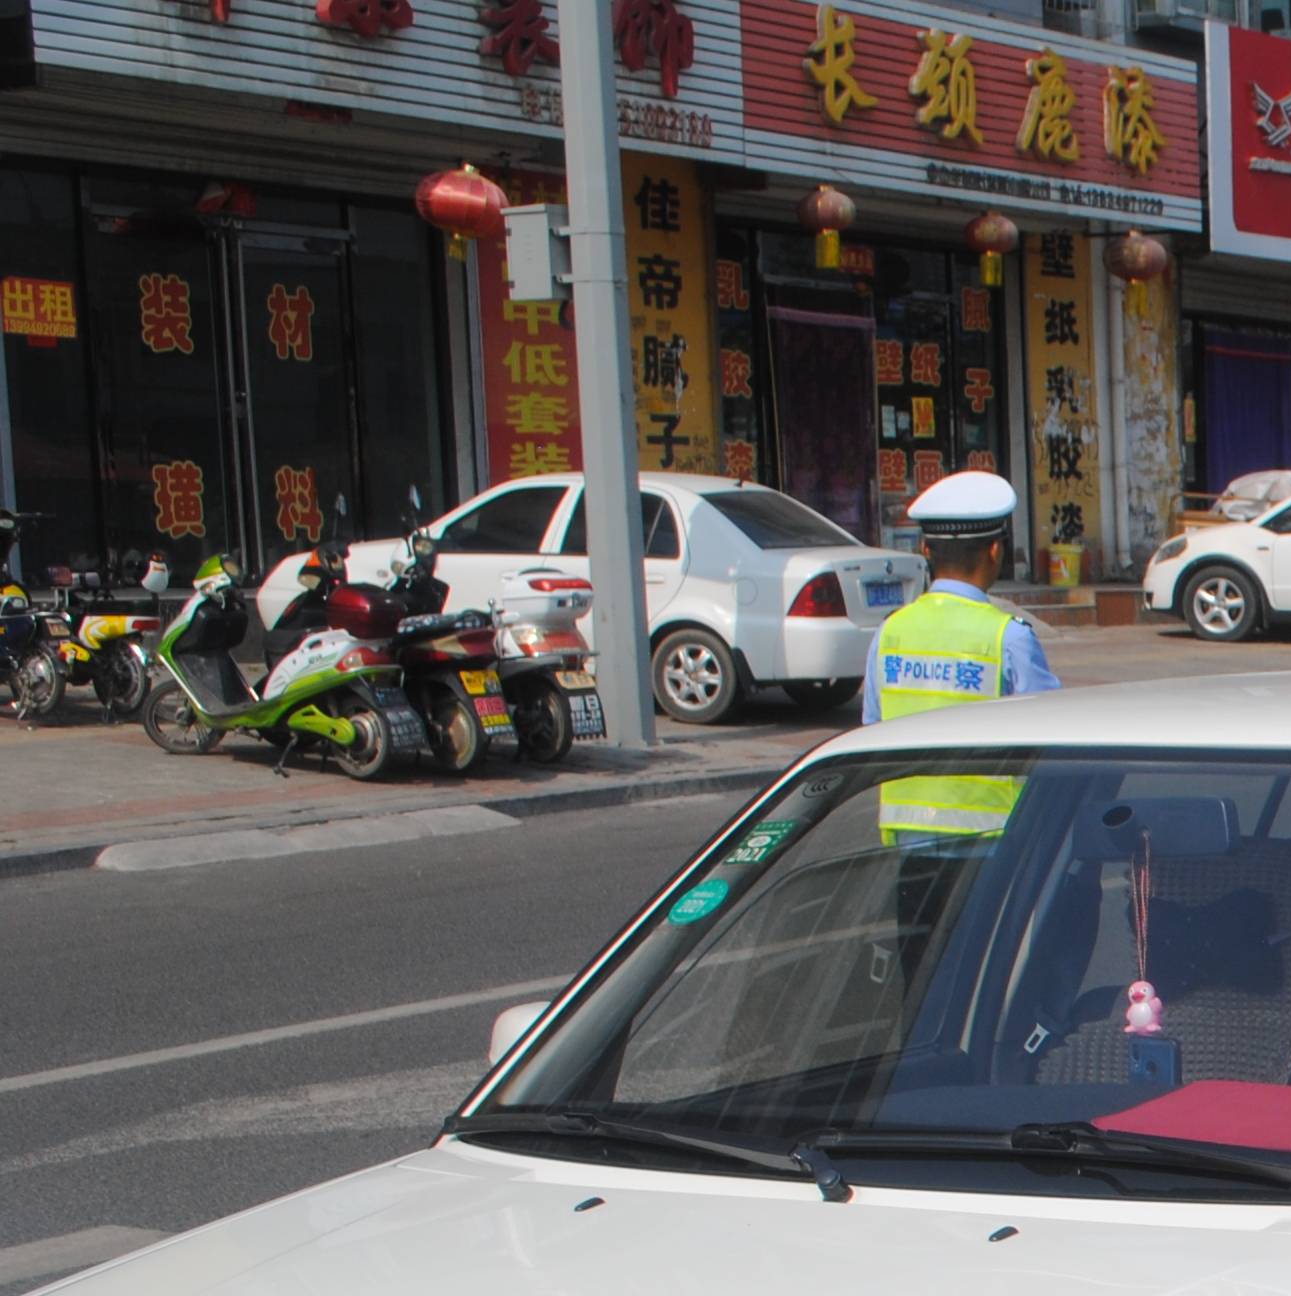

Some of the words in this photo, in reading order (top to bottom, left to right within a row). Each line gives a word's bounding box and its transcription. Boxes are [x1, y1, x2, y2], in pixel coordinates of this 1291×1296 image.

[803, 3, 1165, 174] 长颈鹿漆
[4, 280, 76, 322] 出租
[875, 339, 942, 388] 壁纸
[904, 662, 952, 682] POLICE
[954, 661, 985, 691] 察
